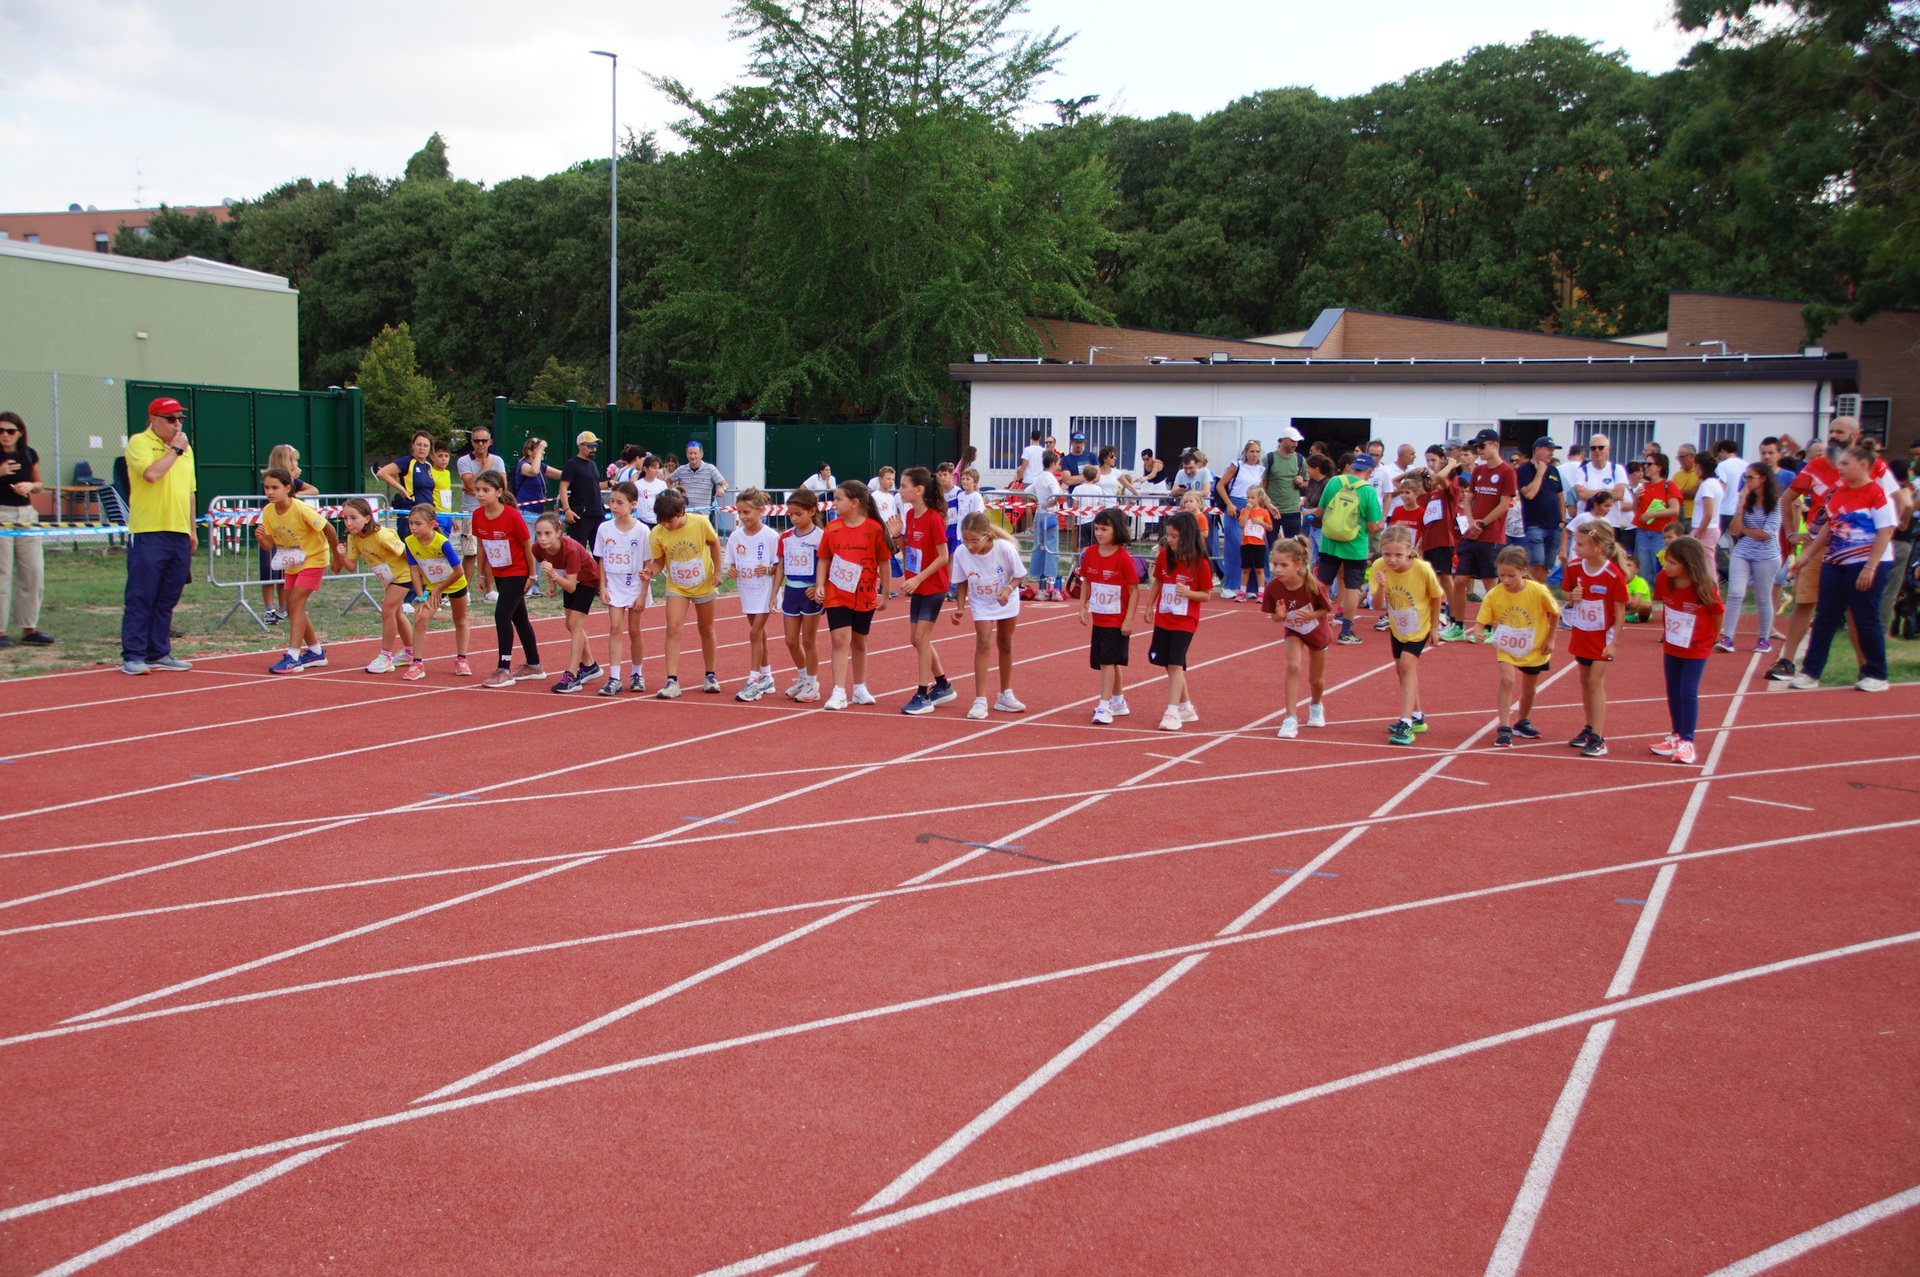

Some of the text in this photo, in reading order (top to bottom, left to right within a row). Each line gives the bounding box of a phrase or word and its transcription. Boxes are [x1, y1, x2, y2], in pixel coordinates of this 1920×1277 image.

[282, 556, 295, 566] 59
[609, 553, 630, 565] 553
[789, 556, 807, 566] 259
[428, 566, 443, 576] 55
[677, 567, 700, 579] 526
[834, 566, 853, 582] 253
[977, 582, 999, 595] 557
[1095, 592, 1114, 604] 107
[1500, 635, 1527, 649] 500
